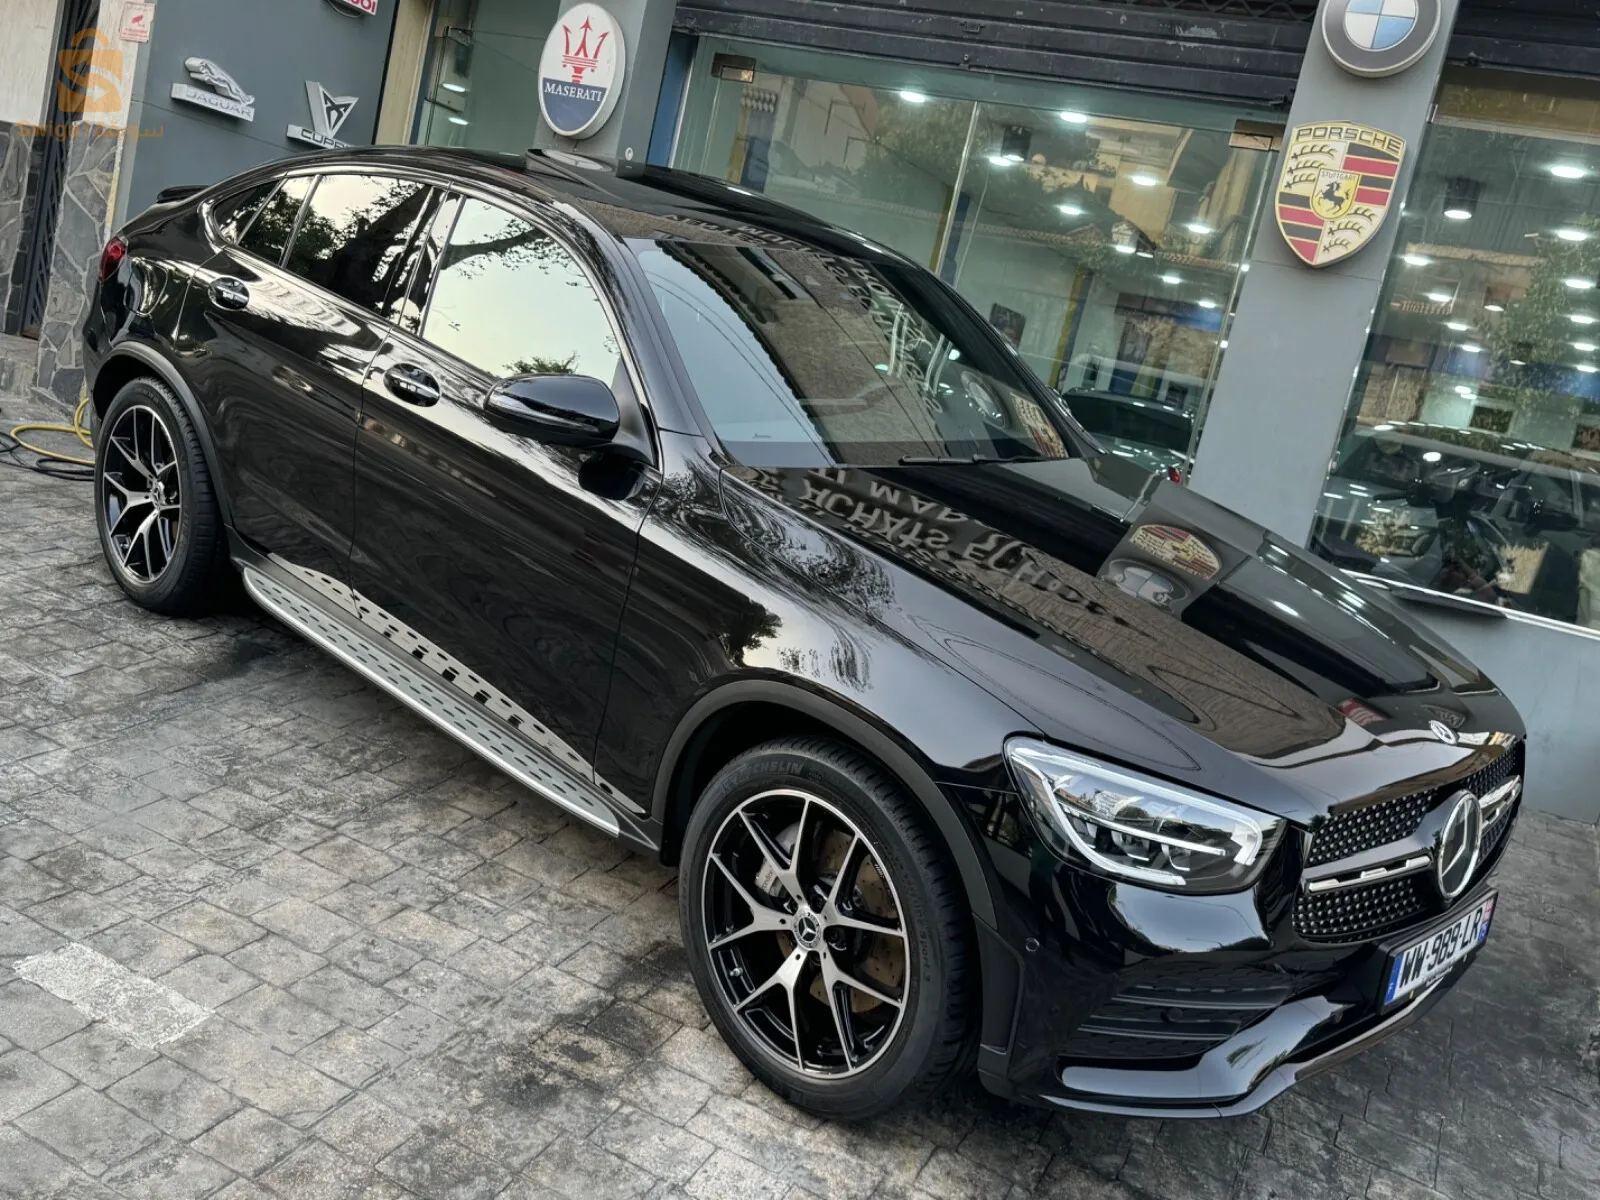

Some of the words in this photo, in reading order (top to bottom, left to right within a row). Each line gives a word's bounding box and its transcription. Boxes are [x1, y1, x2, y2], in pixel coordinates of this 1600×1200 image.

[185, 91, 253, 118] JAGUAR
[544, 82, 603, 102] MASERATI
[1296, 126, 1401, 155] PORSCHE
